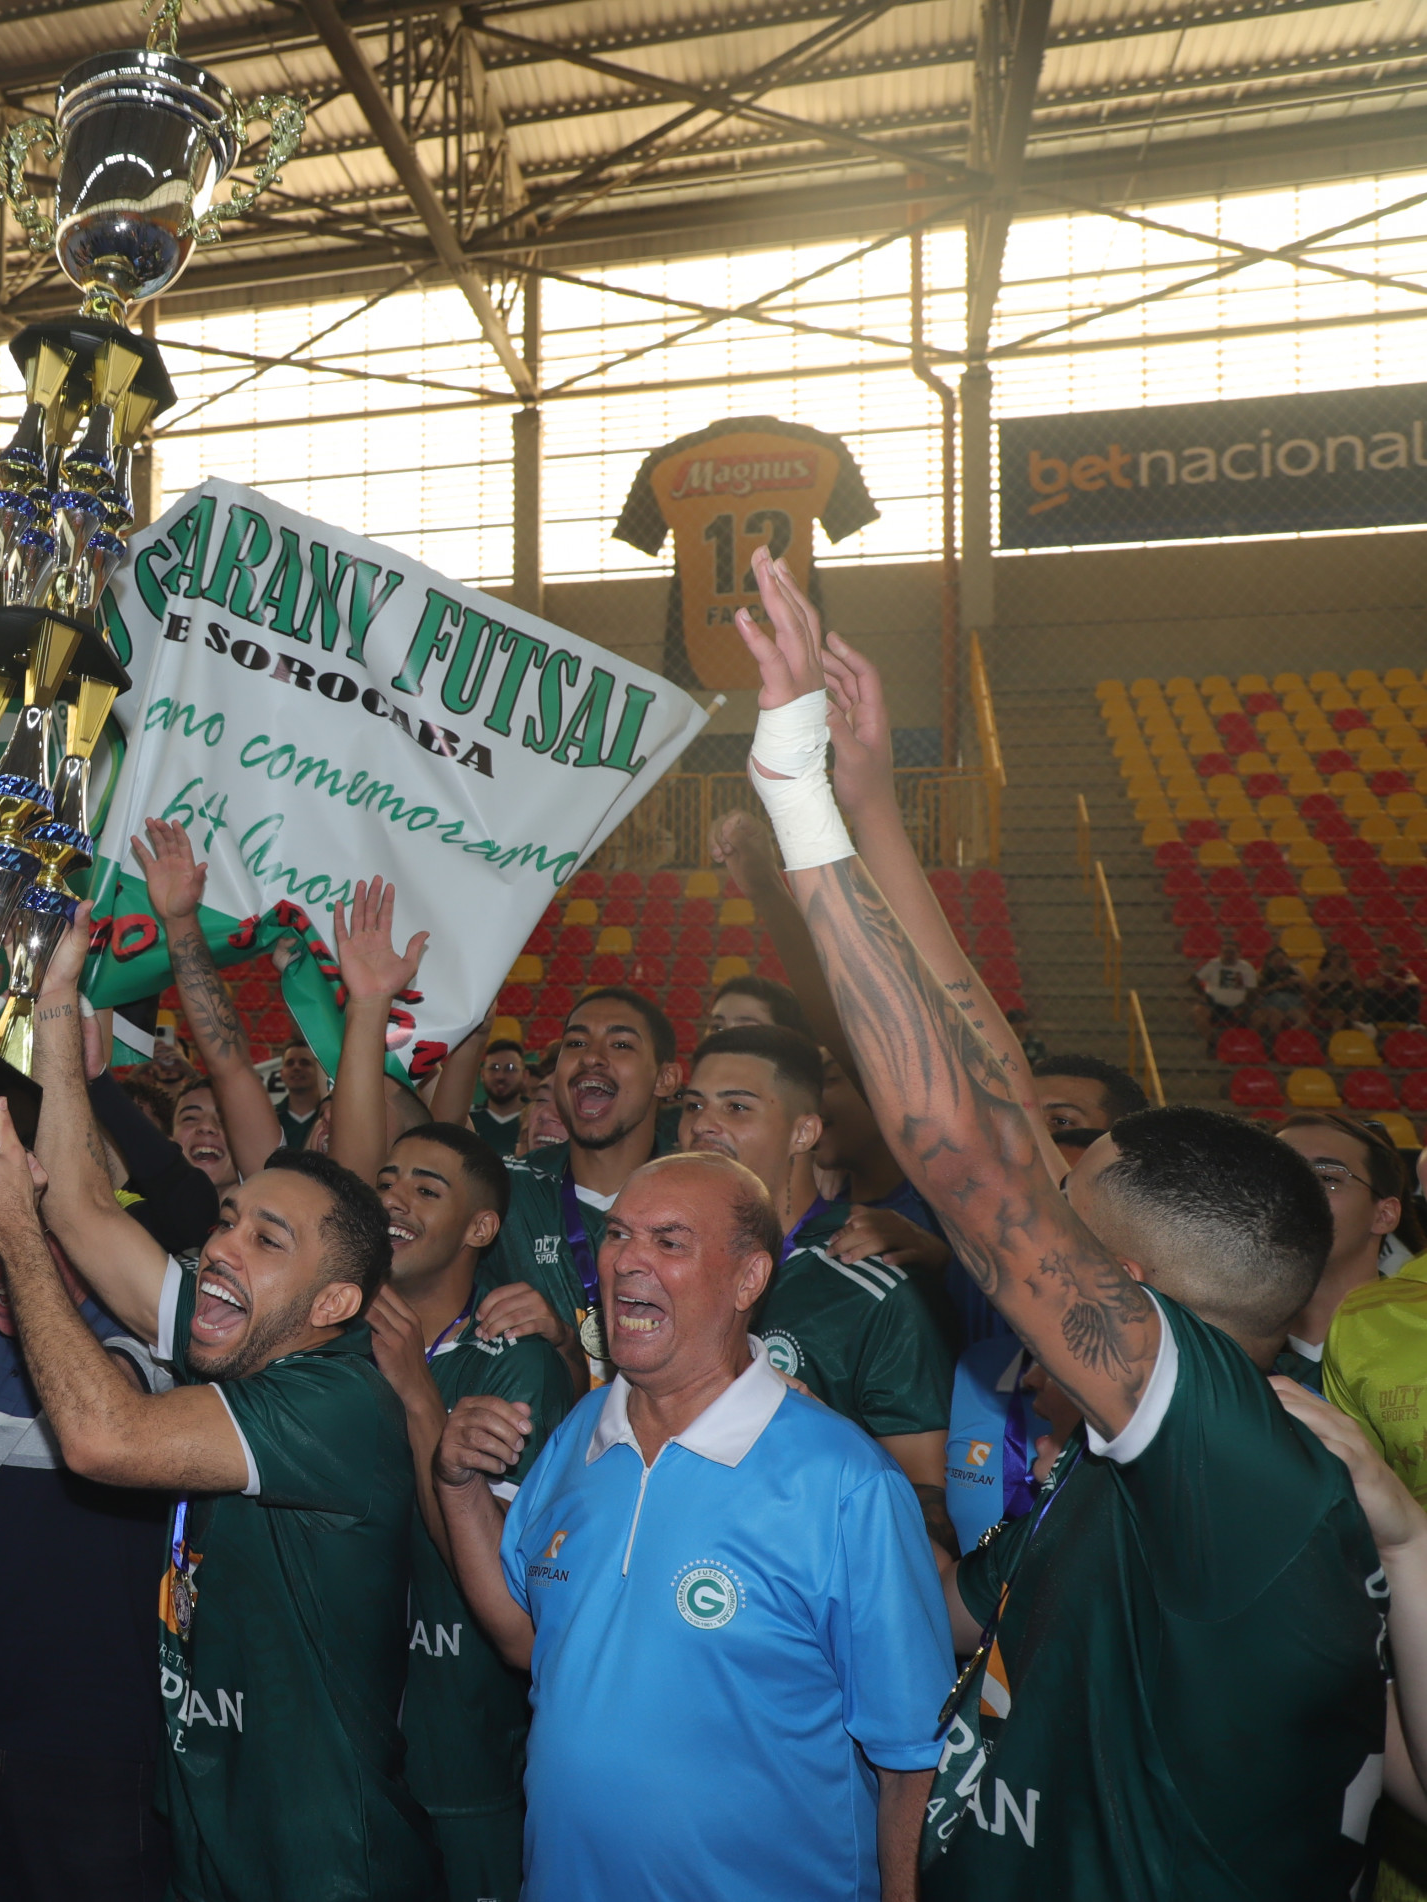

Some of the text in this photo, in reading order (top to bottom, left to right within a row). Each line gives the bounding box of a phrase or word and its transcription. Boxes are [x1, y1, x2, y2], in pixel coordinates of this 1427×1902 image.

[671, 459, 811, 497] Magnus
[204, 622, 496, 779] SOROCABA
[392, 588, 656, 777] FUTSAL
[144, 696, 225, 747] ano
[1379, 1386, 1424, 1409] DUTY
[950, 1468, 995, 1486] SERVPLAN
[528, 1565, 570, 1582] SERVPLAN
[678, 1575, 692, 1613] GUARANY
[697, 1569, 736, 1624] FUTSAL SOROCABA
